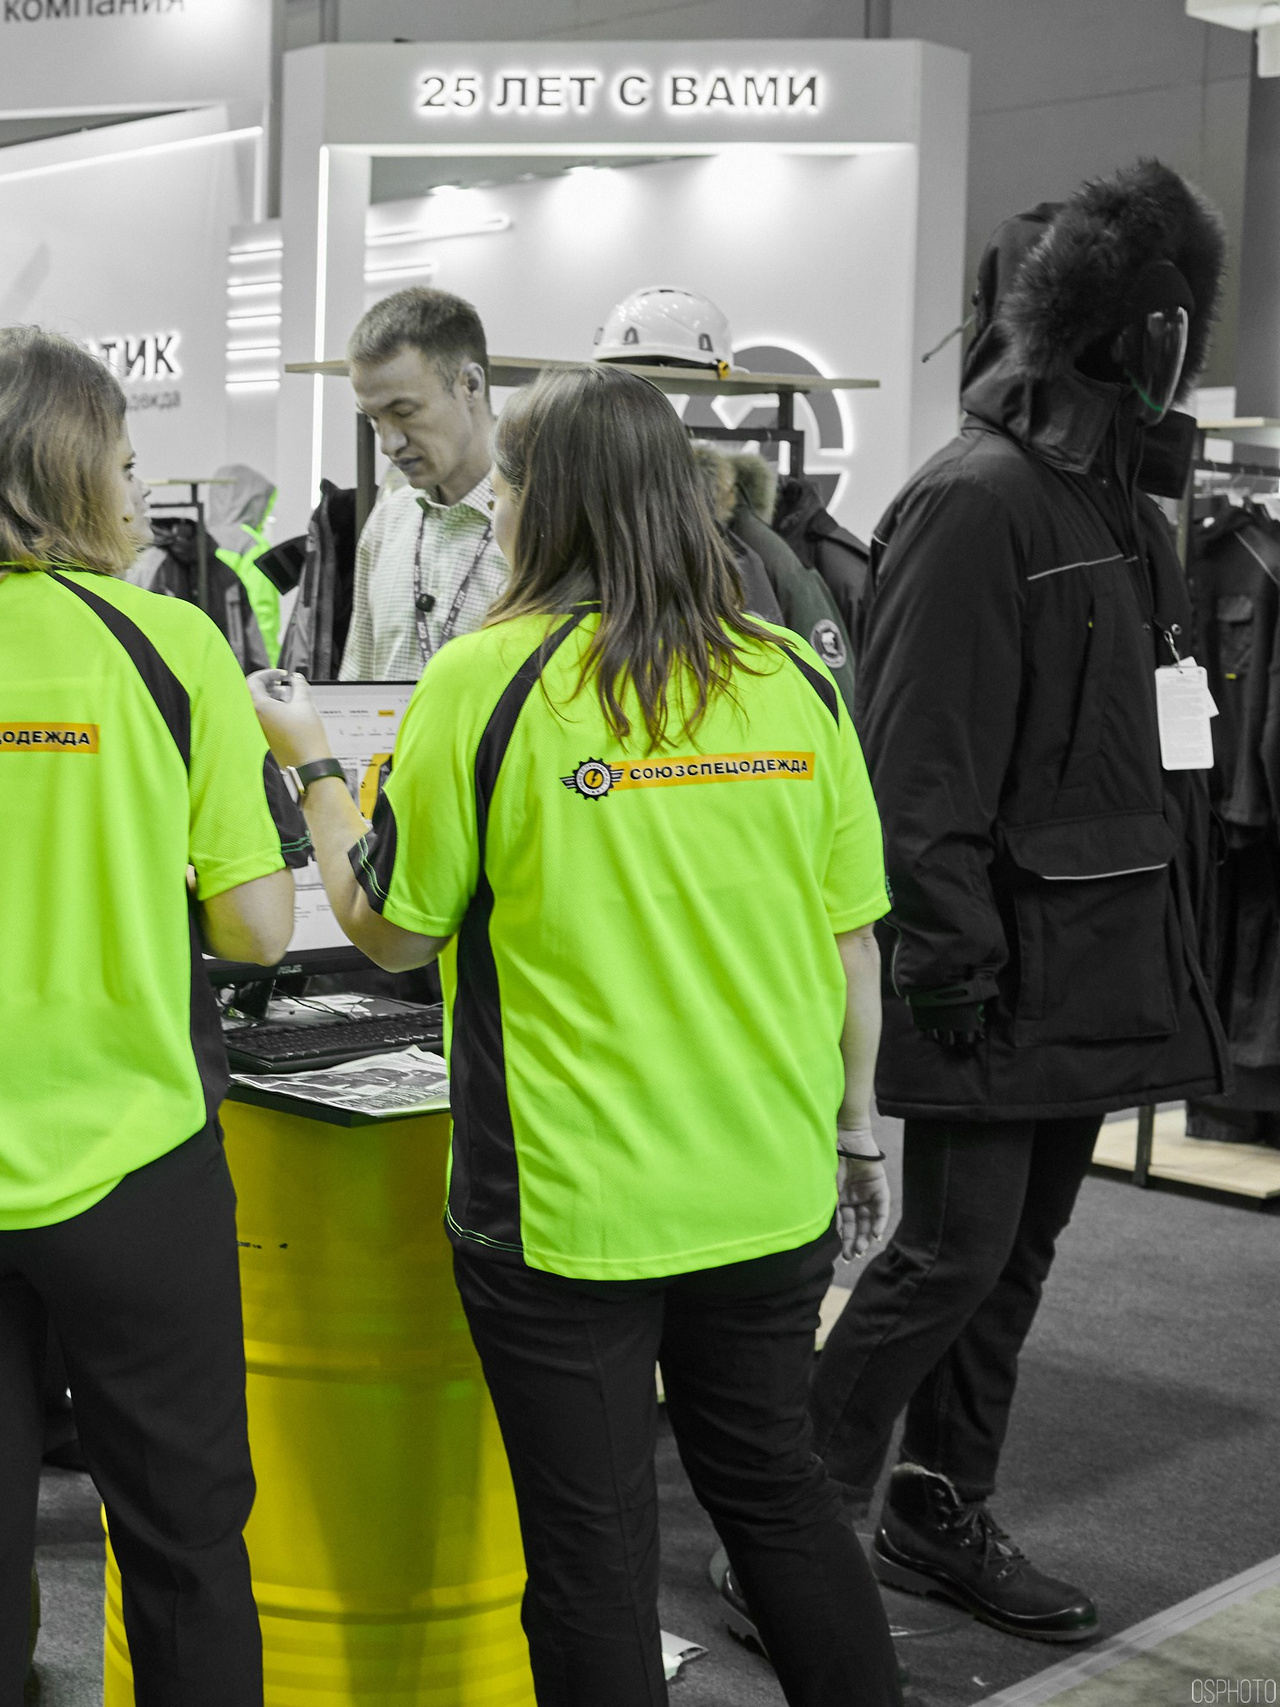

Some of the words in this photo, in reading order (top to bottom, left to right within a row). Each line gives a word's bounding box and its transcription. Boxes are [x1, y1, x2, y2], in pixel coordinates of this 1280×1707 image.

[421, 76, 476, 107] 25
[496, 76, 596, 107] ЛЕТ
[619, 75, 647, 107] С
[670, 75, 818, 107] ВАМИ
[99, 336, 175, 376] ТИК
[629, 758, 809, 781] СОЮЗСПЕЦОДЕЖДА
